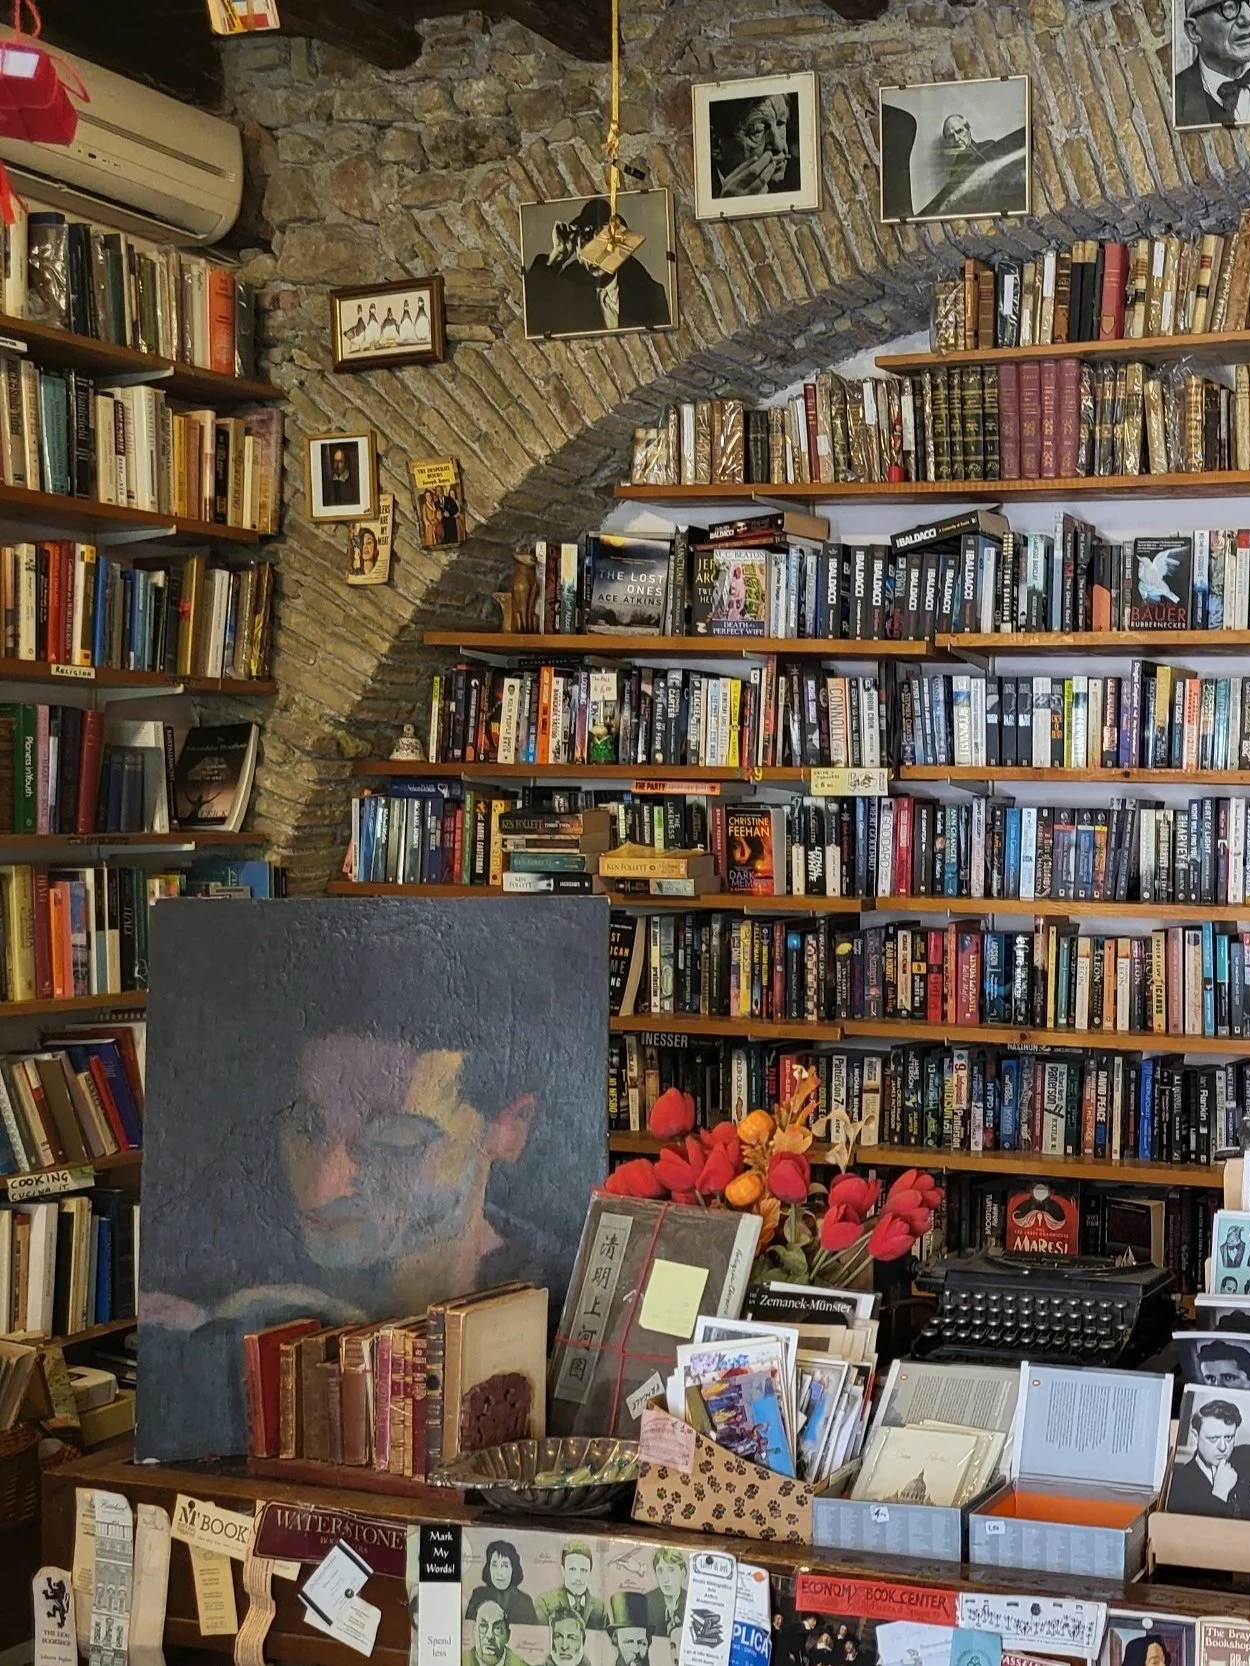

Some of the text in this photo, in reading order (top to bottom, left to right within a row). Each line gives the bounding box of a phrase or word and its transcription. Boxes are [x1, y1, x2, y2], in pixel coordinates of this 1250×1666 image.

[900, 528, 936, 547] BALDACCI
[599, 570, 664, 585] THE LOST
[627, 585, 662, 596] ONES
[925, 571, 935, 610] BALDACCI
[943, 571, 954, 614] BALDACCI
[598, 593, 662, 606] ACE ATKINS
[1131, 607, 1187, 622] BAUER
[712, 628, 742, 636] PERFECT
[723, 621, 748, 629] DEATH
[1130, 621, 1187, 630] RUBBERNECKER
[55, 666, 92, 677] RELIGION
[1175, 681, 1183, 724] ROBERT CRAIS
[830, 688, 845, 741] CONNOLLY
[655, 722, 662, 730] OF
[645, 782, 665, 792] PARTY
[1204, 800, 1212, 820] HEAT
[501, 818, 542, 829] KEN FOLLETT
[728, 816, 769, 826] CHRISTINE
[728, 825, 770, 837] FEEHAN
[475, 822, 485, 874] DANIEL EASTERMAN
[880, 815, 890, 868] GODDARD
[1176, 822, 1187, 859] HARVEY
[621, 863, 647, 871] FOLLETT
[729, 870, 755, 880] DARK
[808, 851, 816, 882] WHITE
[990, 937, 999, 966] LARSSON
[869, 954, 877, 986] Strangers
[969, 954, 977, 980] LYNDA
[1077, 960, 1085, 986] LEON
[1093, 956, 1101, 982] LEON
[1118, 960, 1127, 987] LEON
[645, 1033, 688, 1049] NESSER
[928, 1063, 936, 1073] 13
[833, 1058, 844, 1098] Patterson
[1046, 1066, 1057, 1105] Patterson
[985, 1082, 994, 1127] NYPD RED
[1097, 1071, 1108, 1122] DAVID PEACE
[1199, 1089, 1209, 1121] Rankin
[952, 1110, 963, 1147] Patterson
[11, 1171, 69, 1188] COOKING
[11, 1188, 51, 1201] CUCINA
[984, 1193, 992, 1237] TURTLEDOVE
[1013, 1235, 1068, 1255] MARESI
[759, 1293, 853, 1314] Zemanek-Münster
[429, 1530, 453, 1542] Mark
[432, 1545, 450, 1558] My
[425, 1562, 455, 1574] Words!
[801, 1579, 948, 1617] ECONOMY BOOK CENTER
[41, 1637, 72, 1648] BOOKSHOP
[43, 1630, 71, 1639] THE LION
[427, 1635, 452, 1648] Spend
[1204, 1627, 1250, 1641] The Bray
[431, 1646, 448, 1658] less
